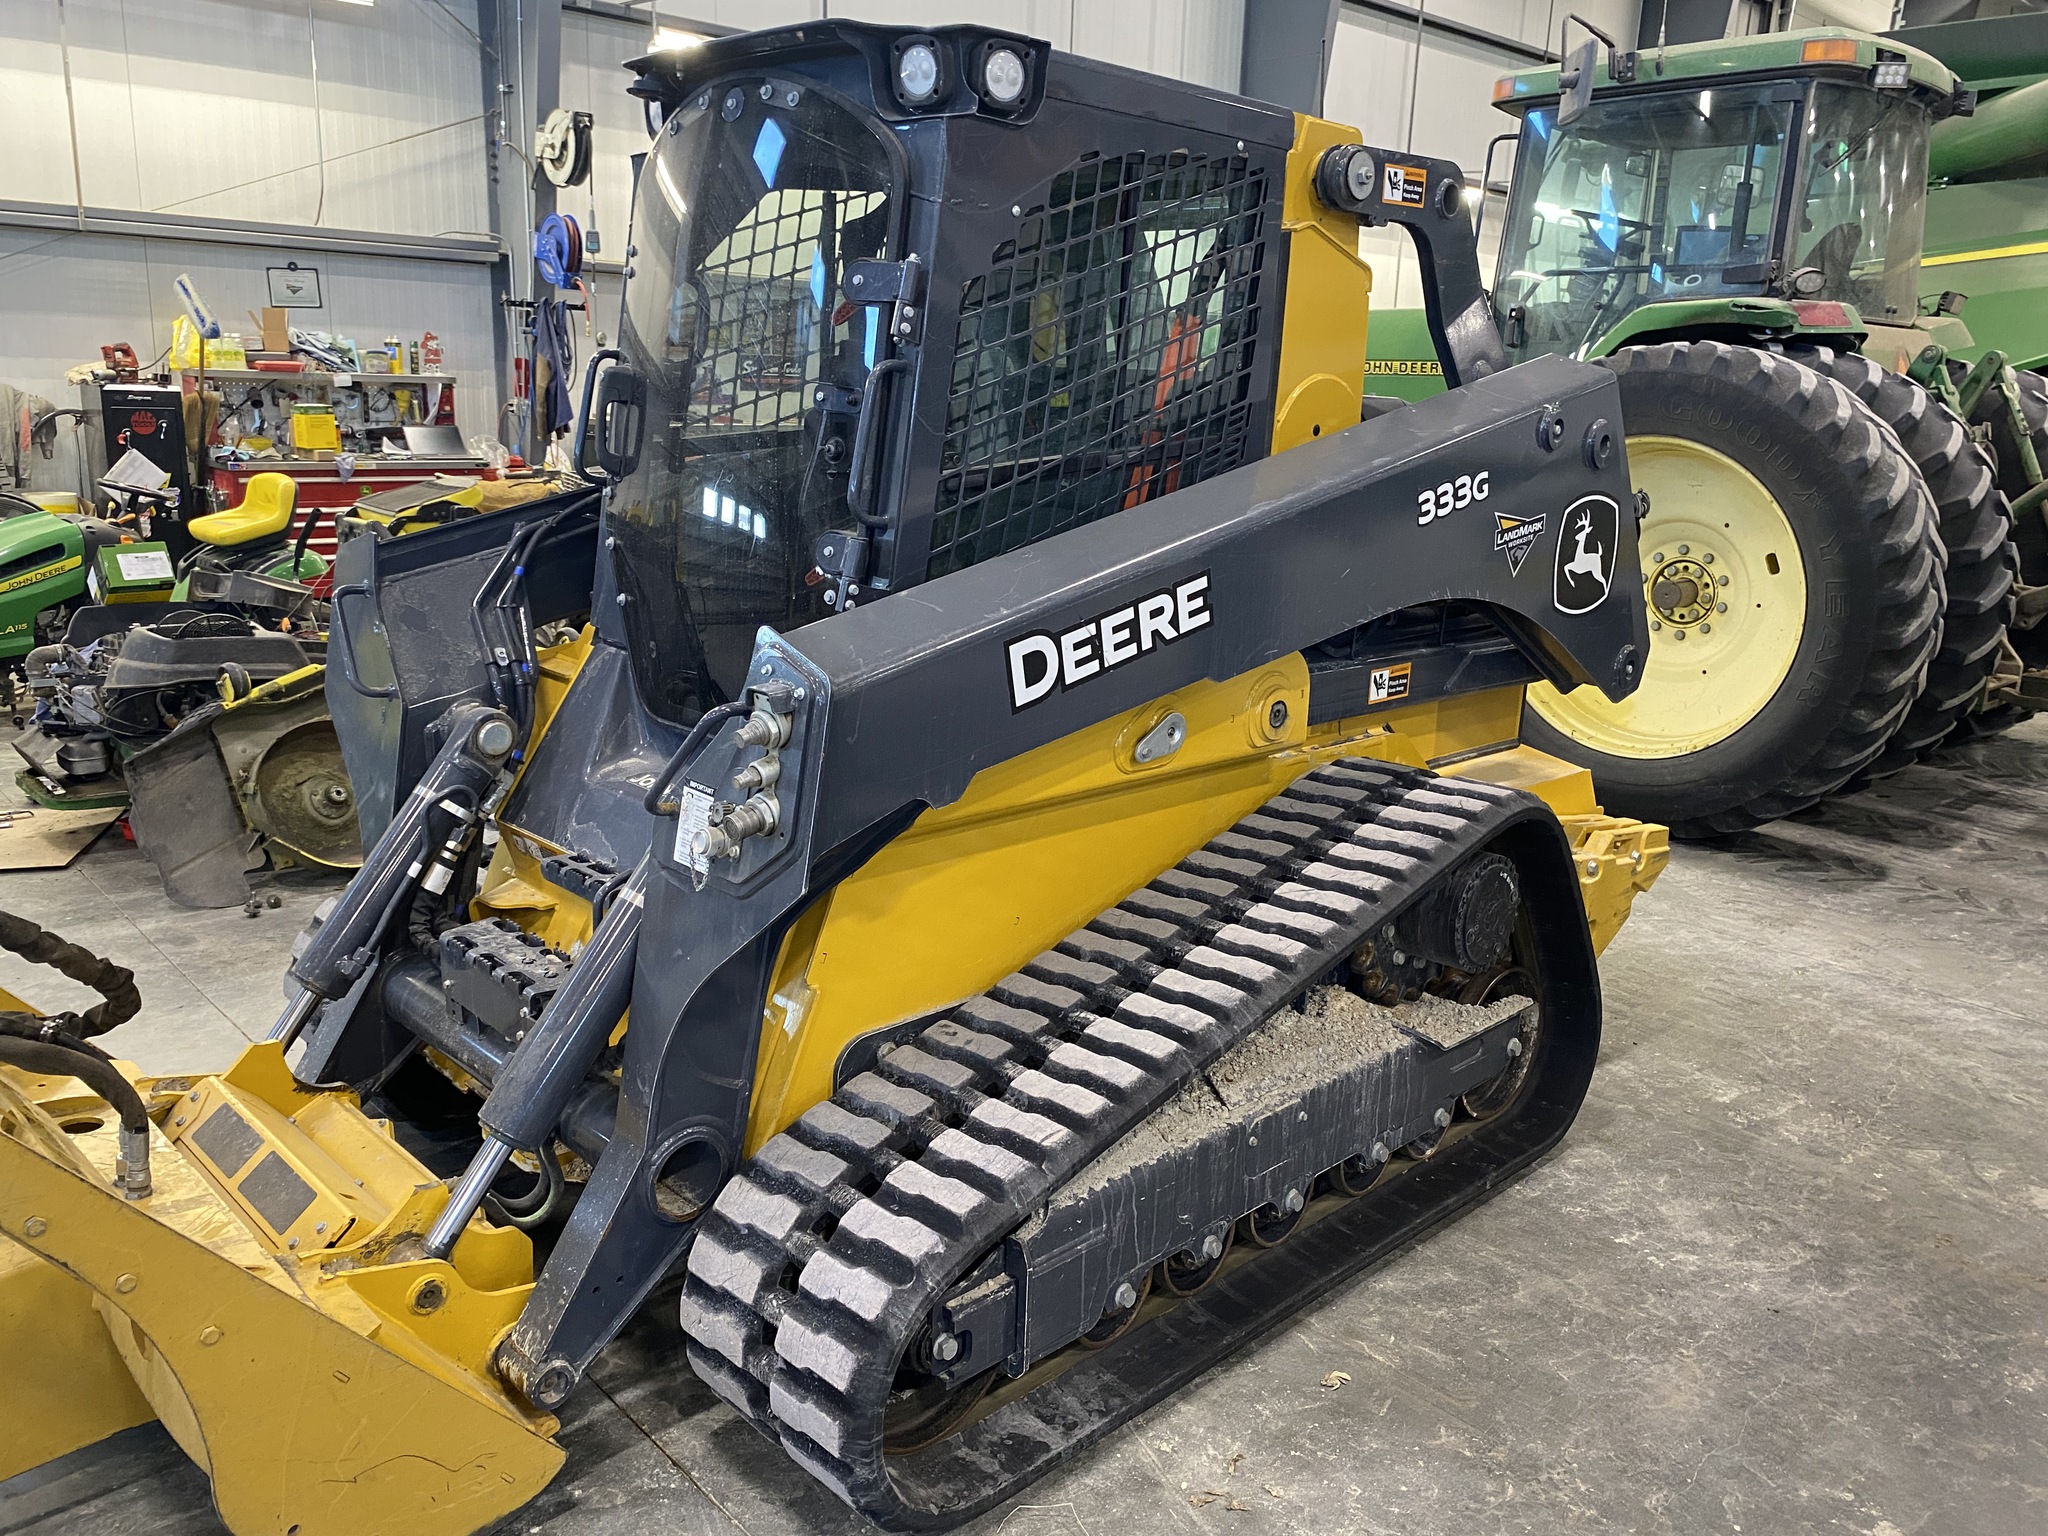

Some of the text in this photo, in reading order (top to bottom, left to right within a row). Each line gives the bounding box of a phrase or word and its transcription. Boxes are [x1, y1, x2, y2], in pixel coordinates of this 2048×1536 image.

[1364, 361, 1442, 373] OHN DEER
[1417, 470, 1489, 525] 333G
[1497, 521, 1543, 544] LANDMARK
[1508, 534, 1534, 548] WORKSITE
[6, 565, 67, 590] JOHN DEERE
[1008, 575, 1211, 708] DEERE
[689, 780, 715, 795] IMPORTANT
